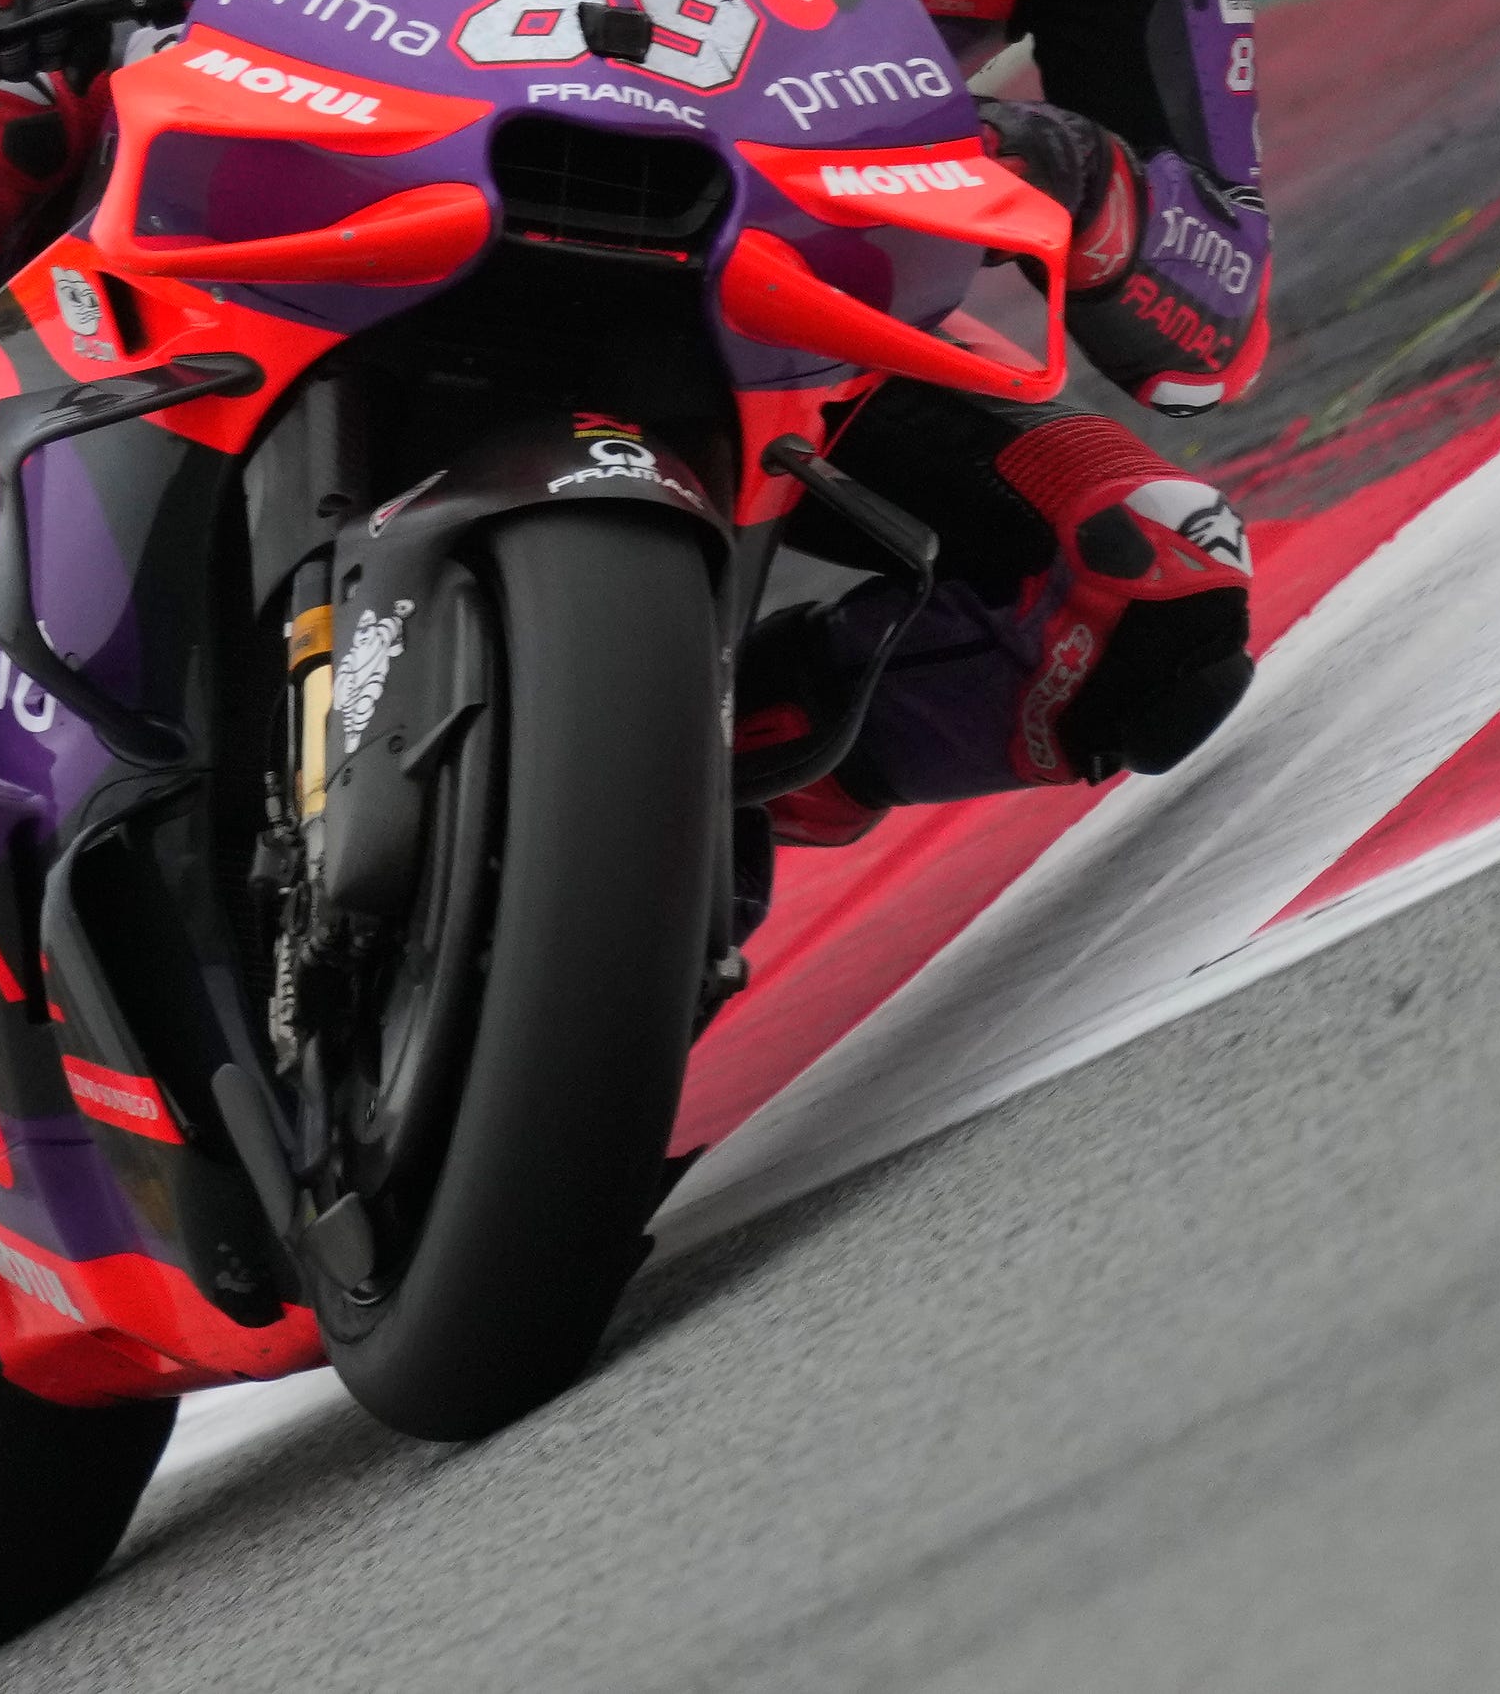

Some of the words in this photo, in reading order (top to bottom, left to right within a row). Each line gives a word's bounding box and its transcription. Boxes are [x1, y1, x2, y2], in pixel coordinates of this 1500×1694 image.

[184, 50, 382, 124] MOTUL
[528, 82, 706, 129] PRAMAC
[764, 57, 952, 130] prima
[820, 158, 984, 198] MOTUL
